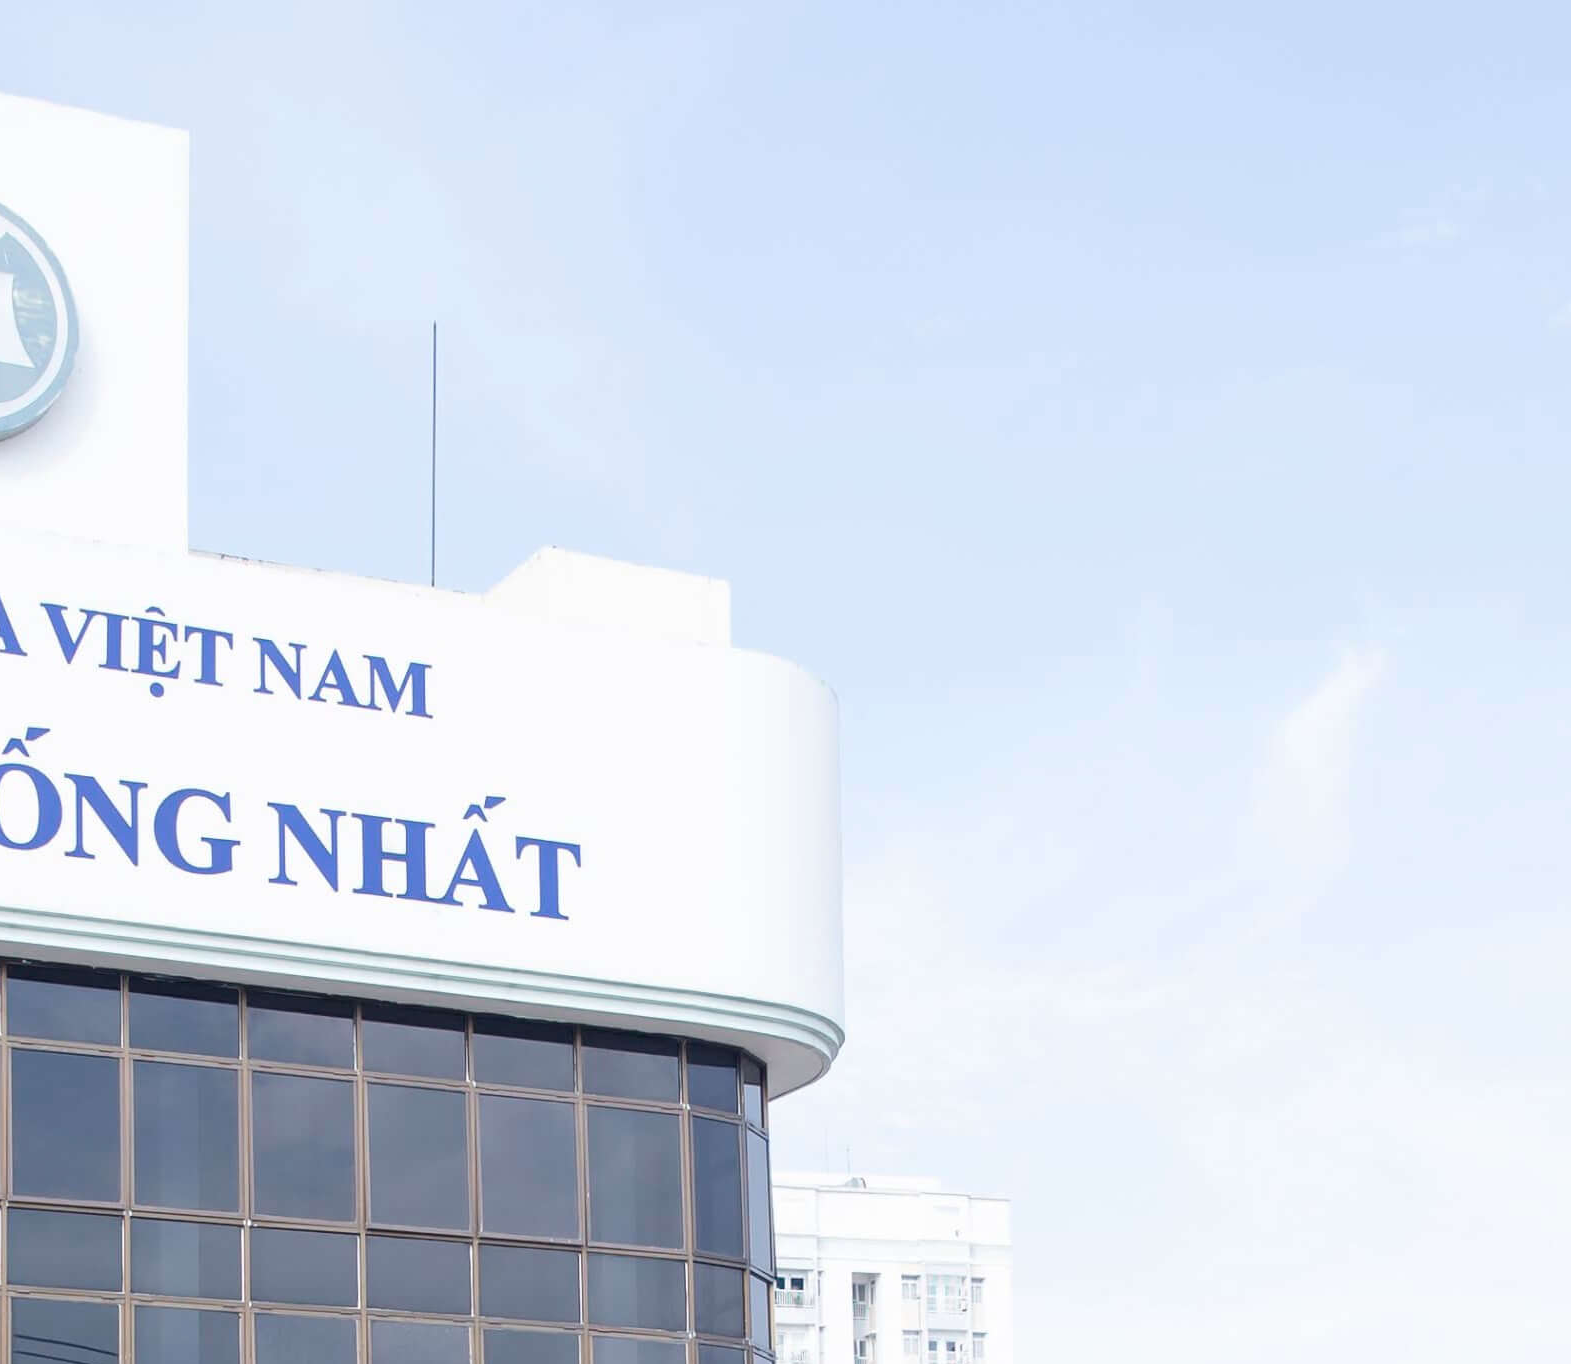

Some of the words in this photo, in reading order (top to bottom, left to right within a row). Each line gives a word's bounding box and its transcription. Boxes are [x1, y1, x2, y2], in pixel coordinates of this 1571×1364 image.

[42, 602, 234, 697] VIỆT
[256, 640, 428, 717] NAM
[268, 795, 582, 920] NHẤT
